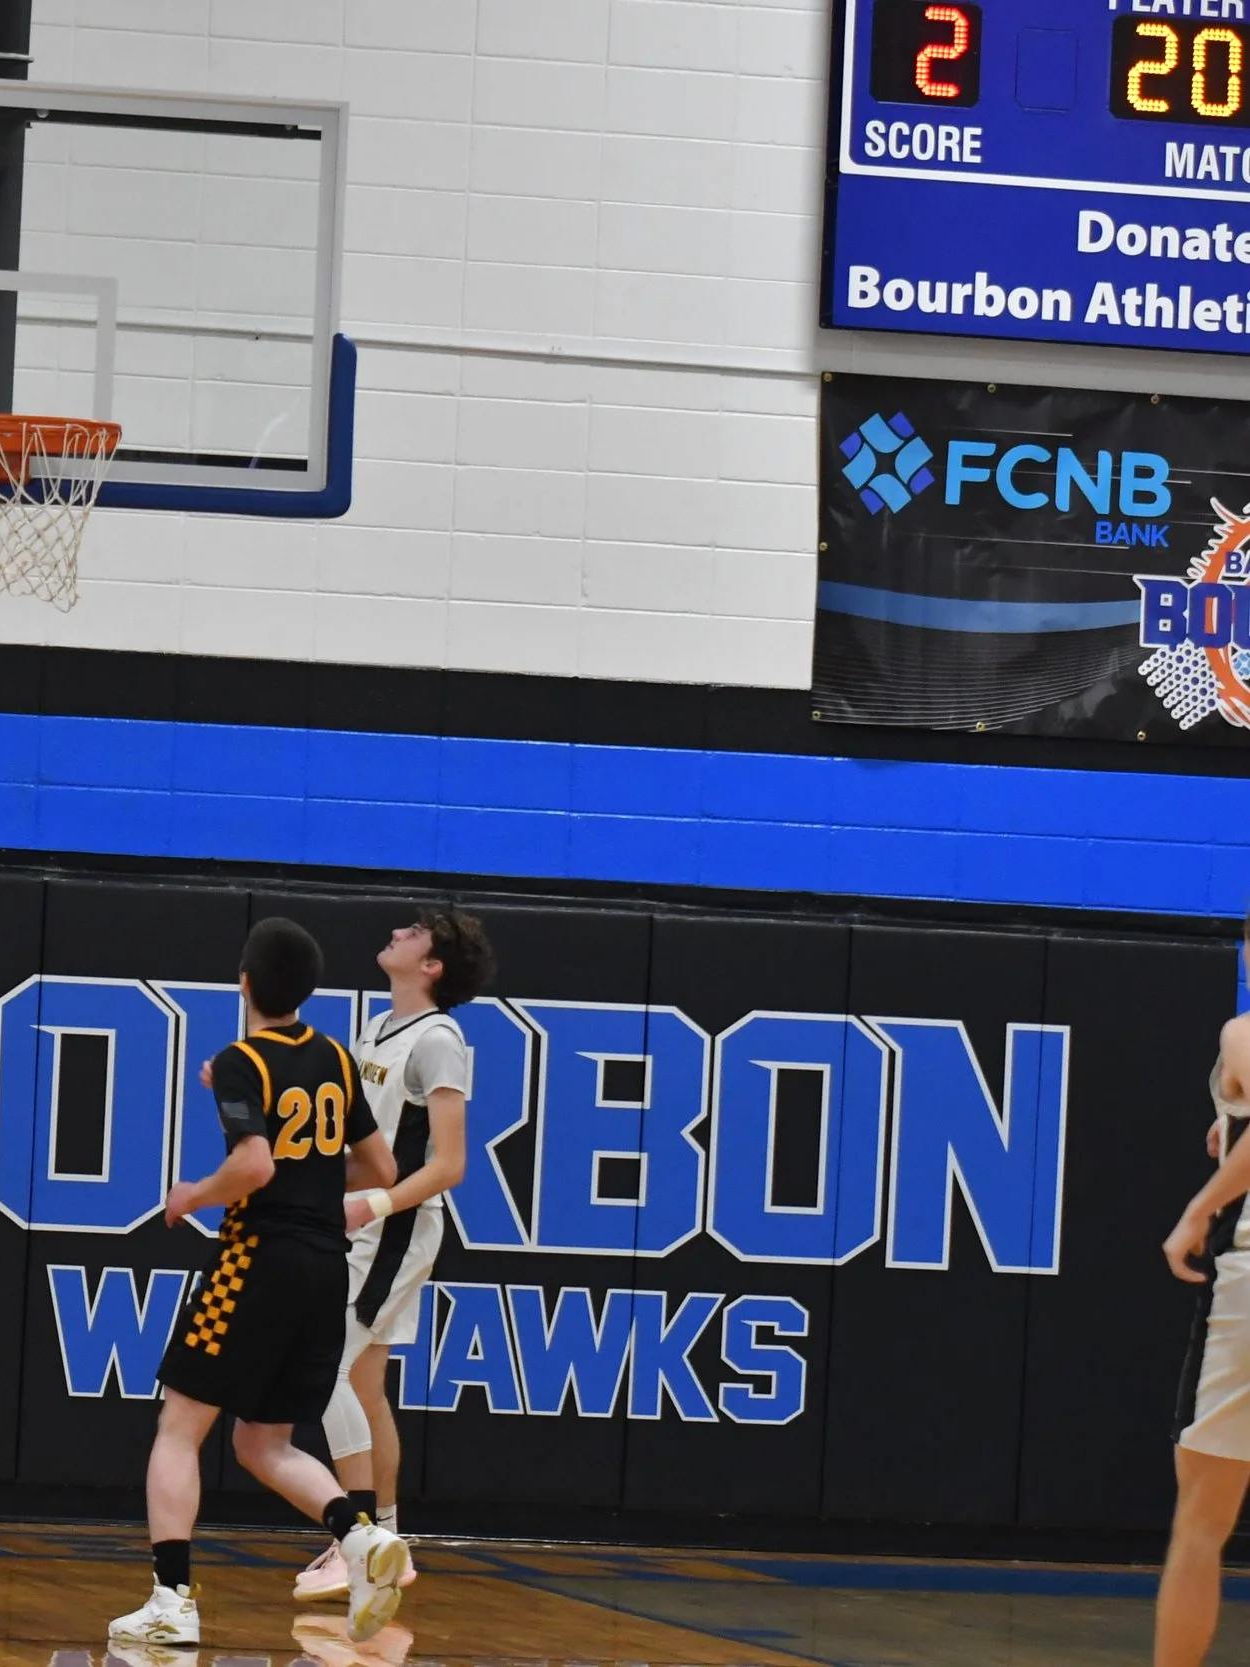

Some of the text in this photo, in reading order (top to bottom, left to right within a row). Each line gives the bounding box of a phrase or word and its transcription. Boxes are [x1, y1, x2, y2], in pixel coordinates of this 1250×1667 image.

[916, 5, 969, 99] 2
[1126, 22, 1242, 118] 20
[864, 119, 983, 165] SCORE
[846, 264, 1072, 323] Bourbon
[944, 440, 1173, 518] FCNB
[1094, 521, 1170, 549] BANK
[272, 1081, 346, 1161] 20
